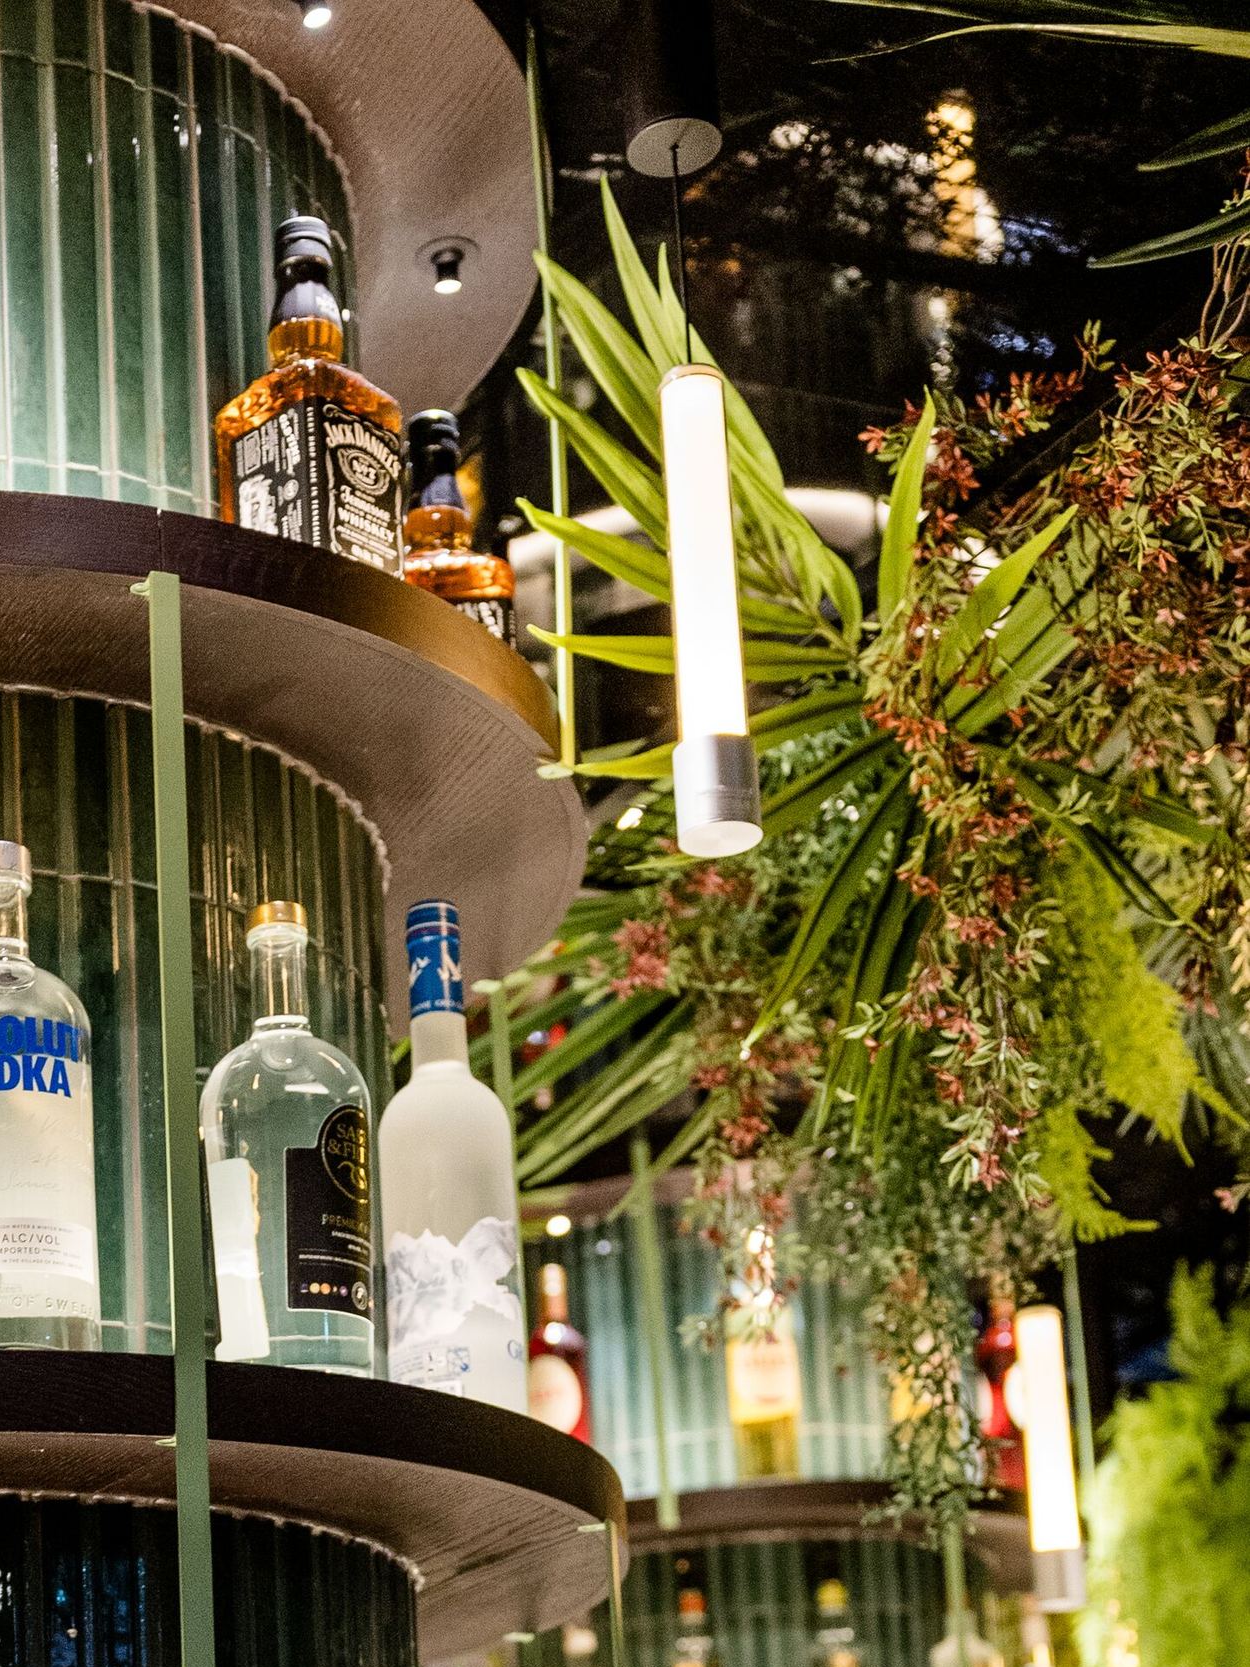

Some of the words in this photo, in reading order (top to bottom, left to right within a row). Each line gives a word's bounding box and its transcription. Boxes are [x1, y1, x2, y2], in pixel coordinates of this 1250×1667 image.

[306, 406, 315, 433] EVERY
[323, 422, 355, 448] JACK
[354, 422, 402, 480] DANIEL'S
[309, 460, 318, 484] MADE
[311, 486, 318, 497] IN
[311, 499, 321, 547] TENNESSEE
[338, 507, 395, 543] WHISKEY
[2, 1232, 61, 1246] ALC/VOL
[12, 1296, 36, 1308] OF
